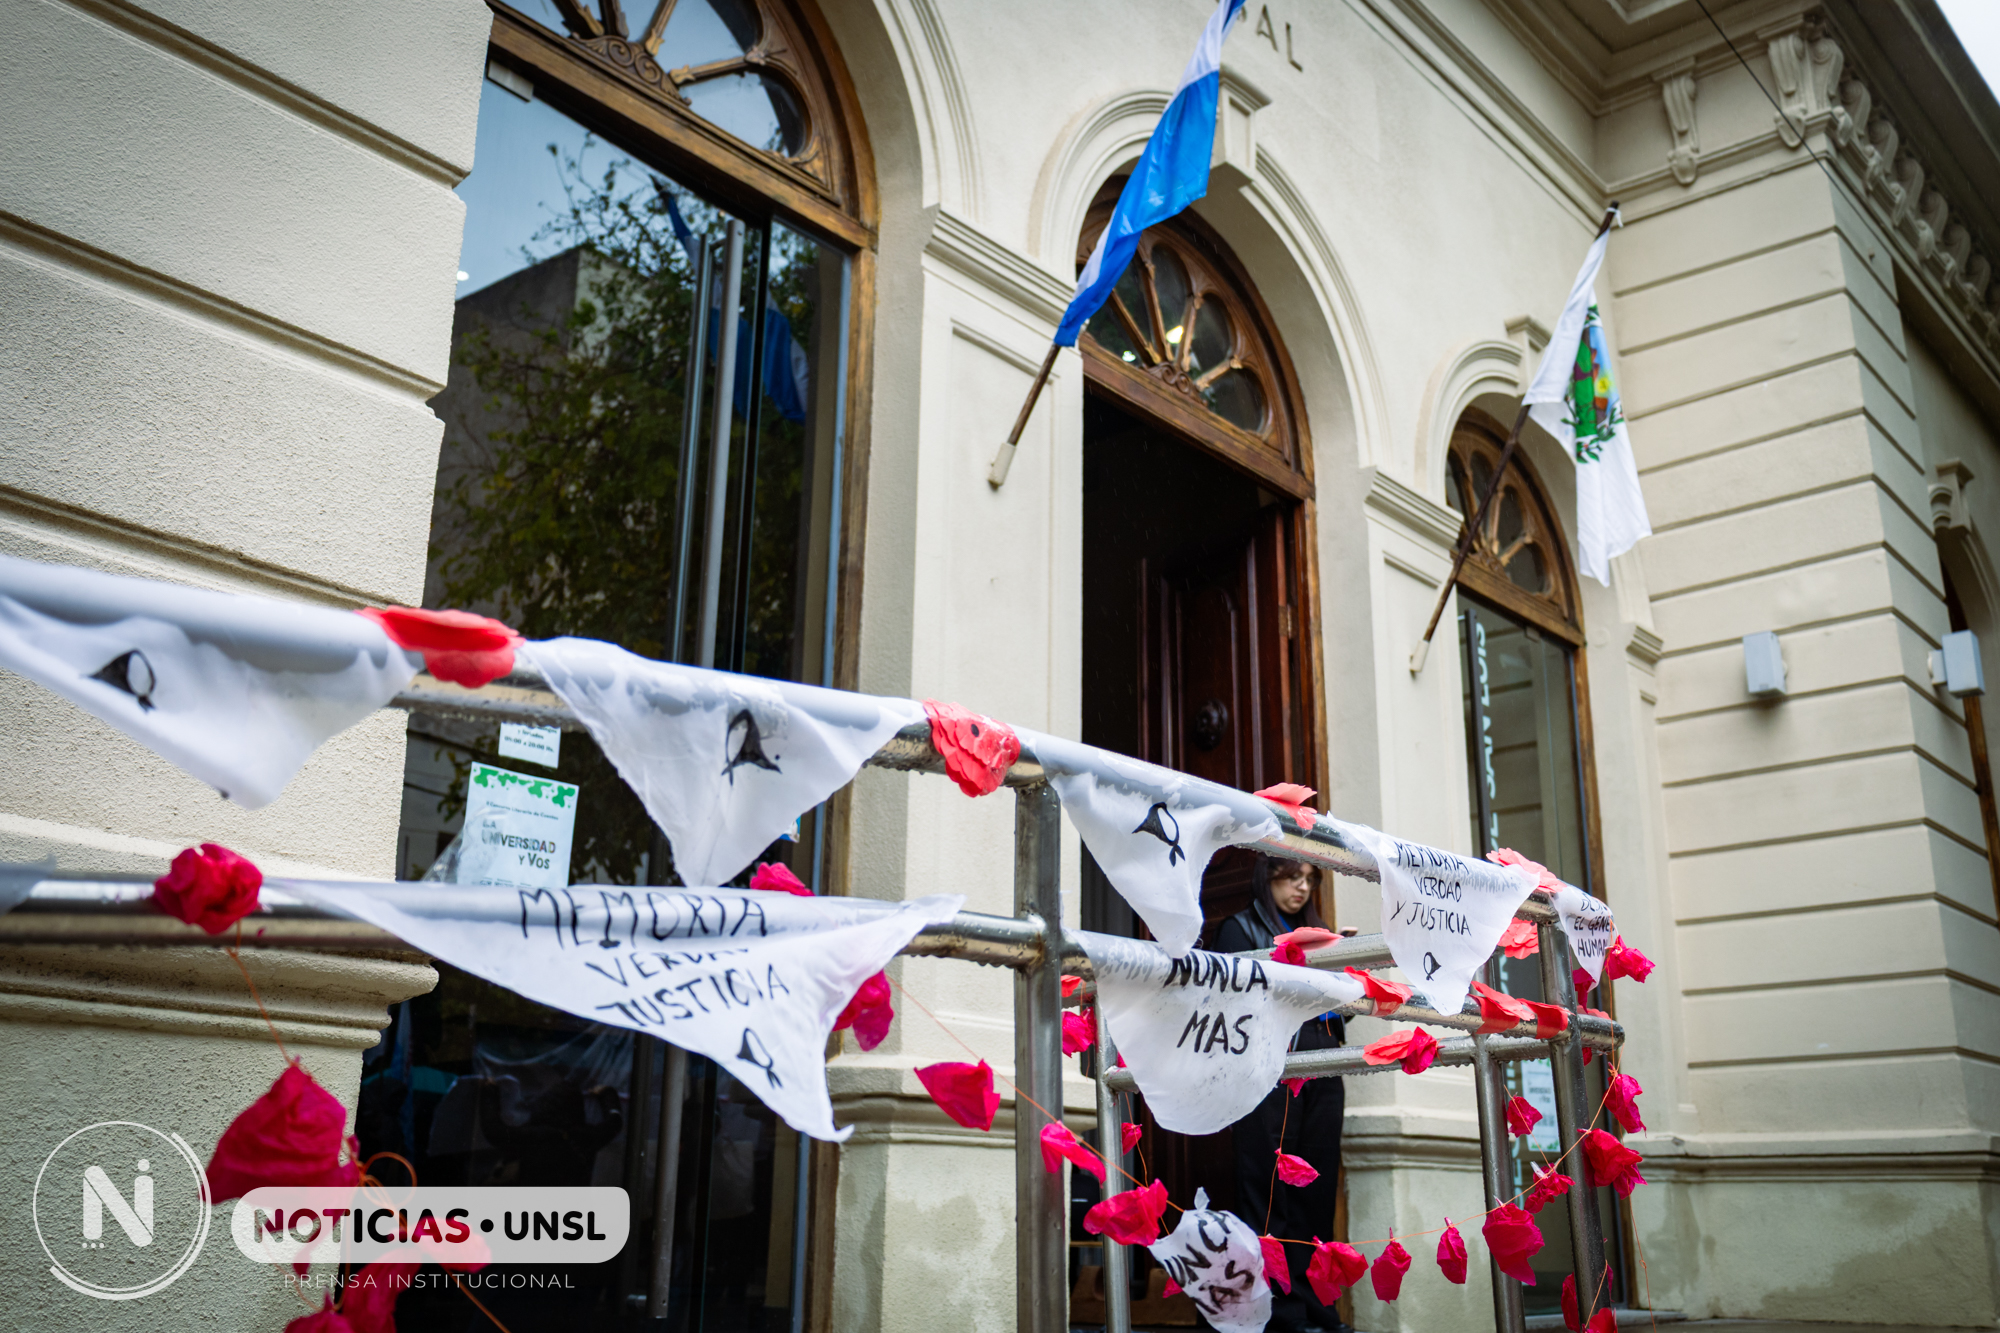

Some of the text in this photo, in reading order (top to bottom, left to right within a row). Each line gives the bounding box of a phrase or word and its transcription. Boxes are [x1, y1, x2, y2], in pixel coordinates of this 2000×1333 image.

[481, 829, 556, 854] UNIVERSIDAD
[1393, 840, 1470, 875] MEMORIA
[1413, 875, 1462, 903] VERDAD
[519, 888, 768, 950] MEMORIA
[1389, 900, 1472, 937] Y JUSTICIA
[1163, 950, 1269, 993] NUNCA
[595, 963, 790, 1027] JUSTICIA
[1176, 1009, 1253, 1055] MAS
